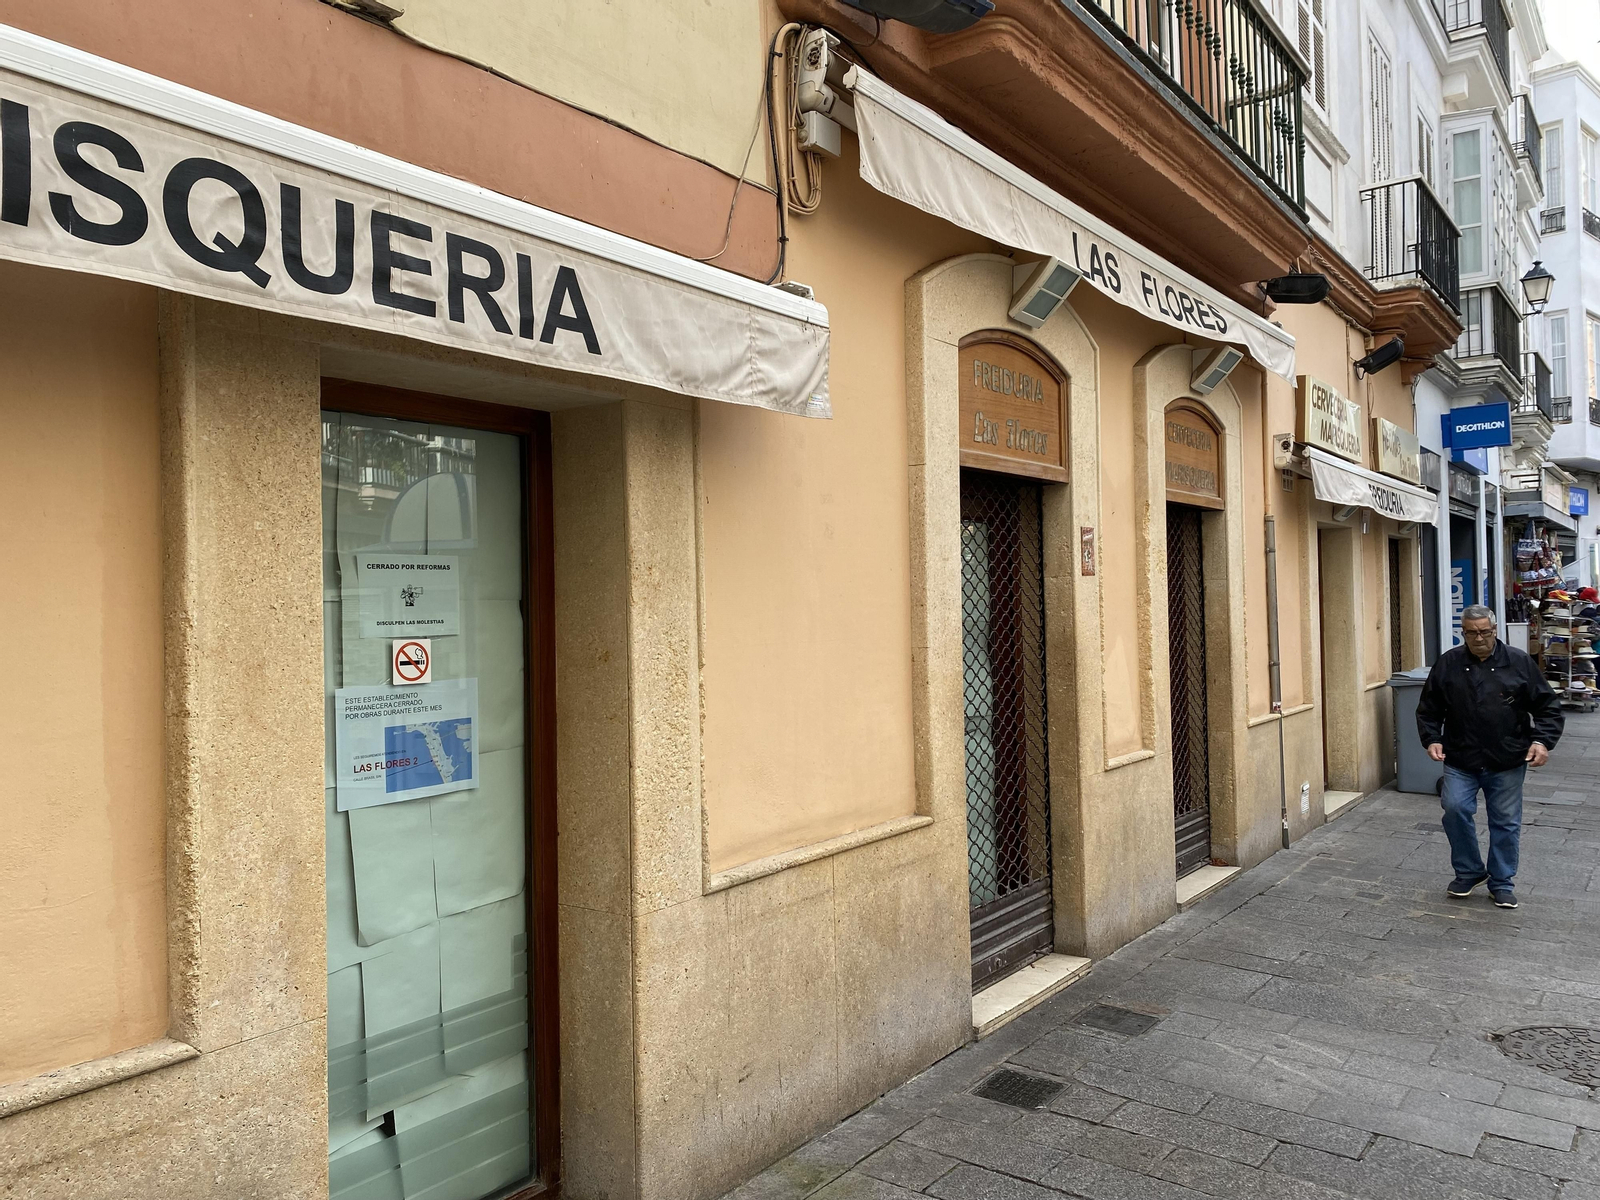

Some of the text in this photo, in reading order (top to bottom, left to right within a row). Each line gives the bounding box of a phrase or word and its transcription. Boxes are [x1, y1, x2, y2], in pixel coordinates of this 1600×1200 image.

[0, 98, 602, 355] ISQUERIA
[1072, 232, 1228, 334] LAS FLORES
[974, 359, 1045, 405] FREIDURIA
[974, 411, 1048, 455] Las Flores
[1167, 421, 1212, 453] CERVECERIA
[1456, 421, 1505, 433] DECATHLON
[345, 692, 419, 705] ESTE ESTABLECIMIENTO
[345, 699, 423, 712] PERMANECERA CERRADO
[360, 710, 382, 719] OBRAS
[383, 707, 411, 717] DURANTE
[413, 706, 429, 714] ESTE
[429, 704, 443, 712] MES
[353, 756, 419, 774] LAS FLORES 2
